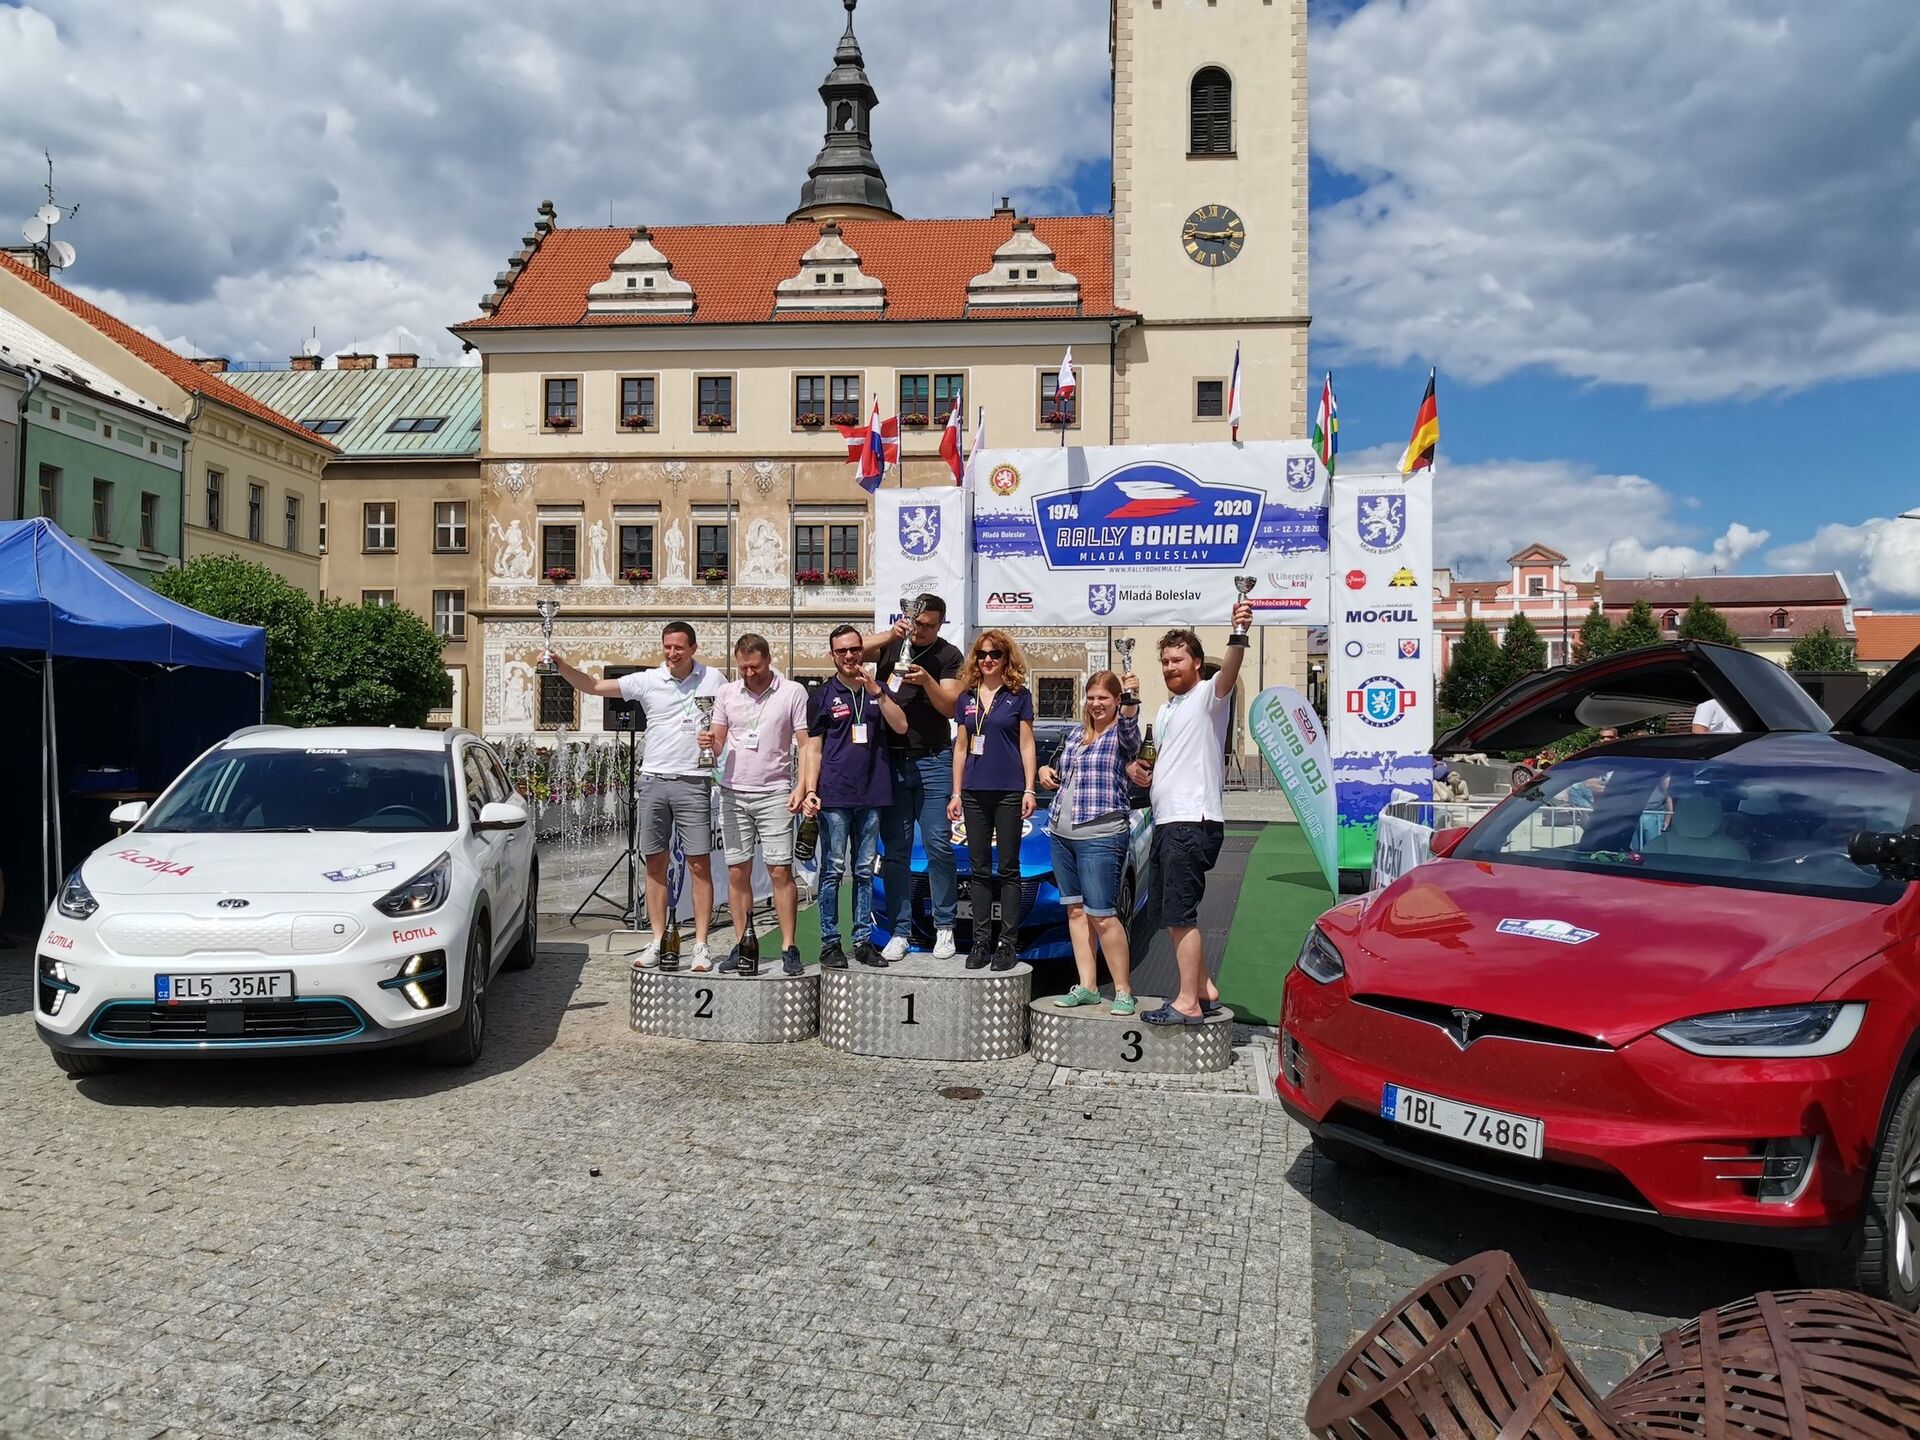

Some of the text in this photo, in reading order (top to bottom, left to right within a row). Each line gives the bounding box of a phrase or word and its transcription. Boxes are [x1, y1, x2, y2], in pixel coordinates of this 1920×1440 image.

[1047, 504, 1079, 520] 1974
[1214, 500, 1252, 516] 2020
[982, 531, 1026, 539] Mladá Boleslav
[1056, 523, 1239, 548] RALLY BOHEMIA
[1263, 526, 1274, 534] 10.
[1302, 525, 1320, 533] 2020
[1134, 550, 1209, 561] BOLESLAV
[1275, 573, 1314, 583] Liberecký
[1291, 580, 1307, 589] kraj
[986, 591, 1033, 604] ABS
[1118, 588, 1202, 601] Mladá Boleslav
[1252, 597, 1302, 608] Středočeský kraj
[1345, 609, 1418, 623] MOGUL
[108, 849, 194, 876] FLOTILA
[45, 930, 74, 950] FLOTILA
[393, 926, 438, 944] FLOTILA
[158, 990, 169, 998] CZ
[174, 975, 281, 998] EL5 35AF
[694, 988, 713, 1018] 2
[900, 993, 920, 1025] 1
[1120, 1030, 1143, 1063] 3
[1402, 1094, 1528, 1150] 1BL 7486
